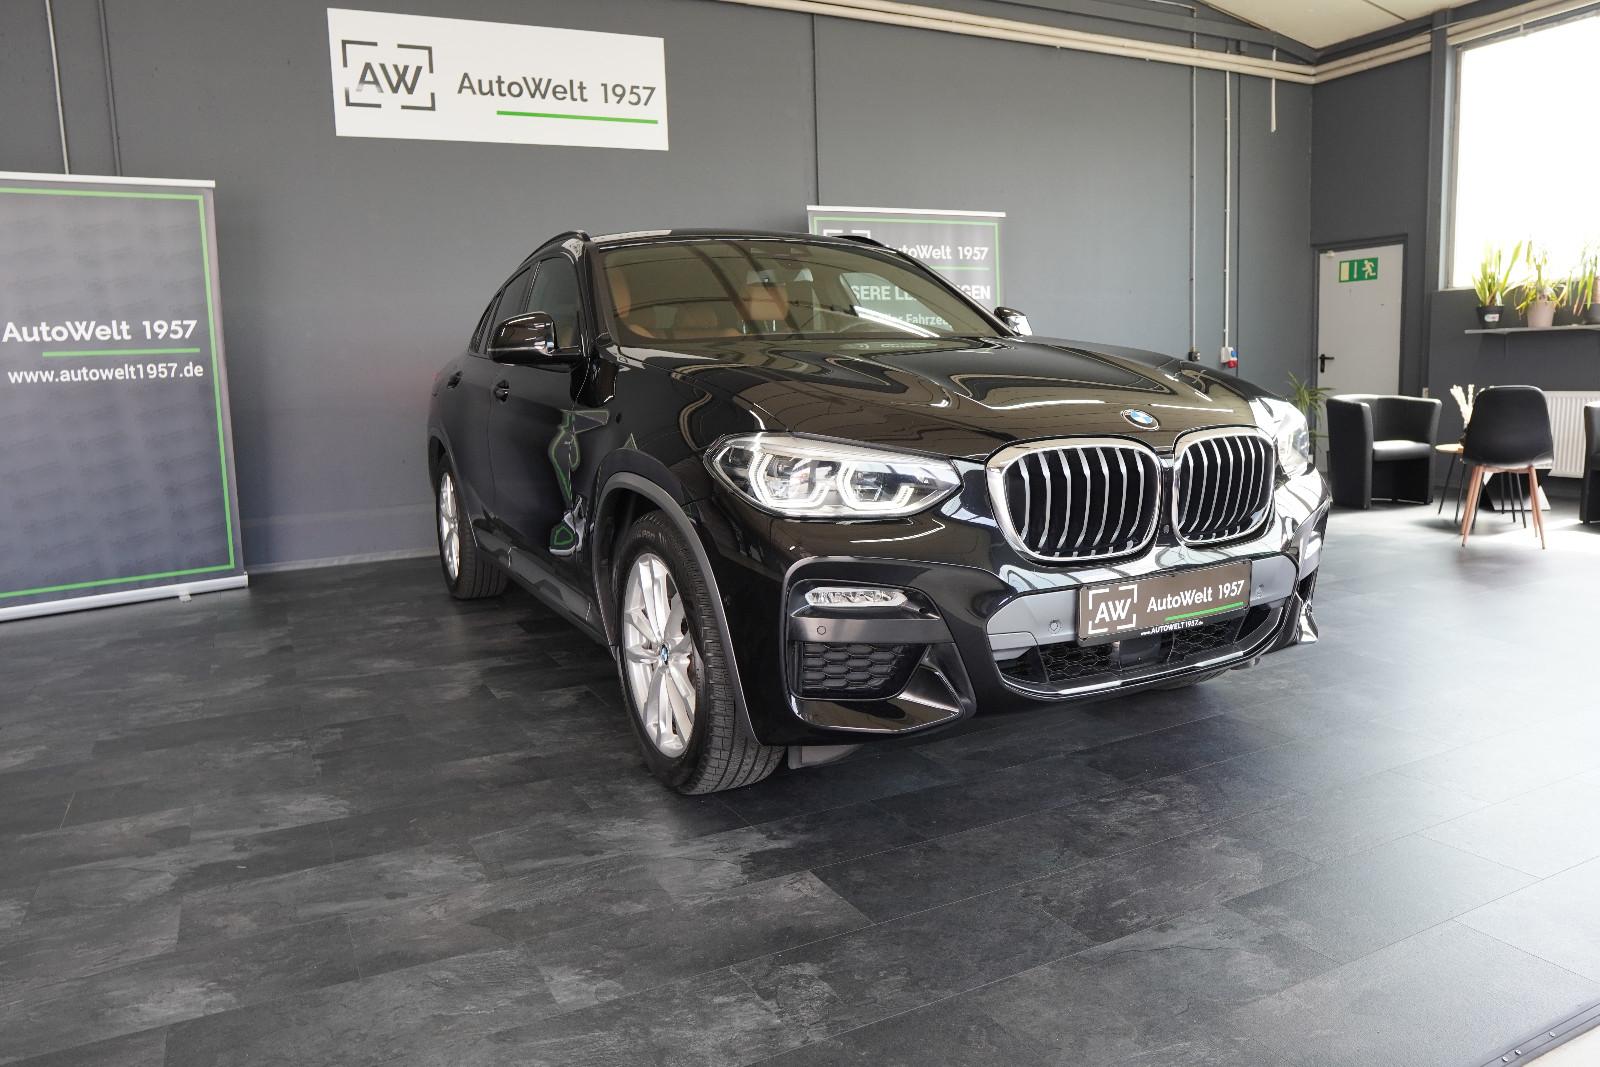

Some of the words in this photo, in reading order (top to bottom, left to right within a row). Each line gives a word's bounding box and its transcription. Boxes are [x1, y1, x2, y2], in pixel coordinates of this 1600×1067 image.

[355, 62, 423, 95] AW
[457, 73, 588, 102] AutoWelt
[601, 83, 656, 106] 1957
[886, 244, 951, 260] toWelt
[958, 246, 989, 260] 1957
[2, 320, 131, 342] AutoWelt
[142, 319, 198, 340] 1957
[8, 361, 203, 384] www.autowelt1957.de
[1147, 587, 1213, 613] AutoWelt
[1218, 580, 1245, 599] 1957
[1095, 599, 1131, 624] AW
